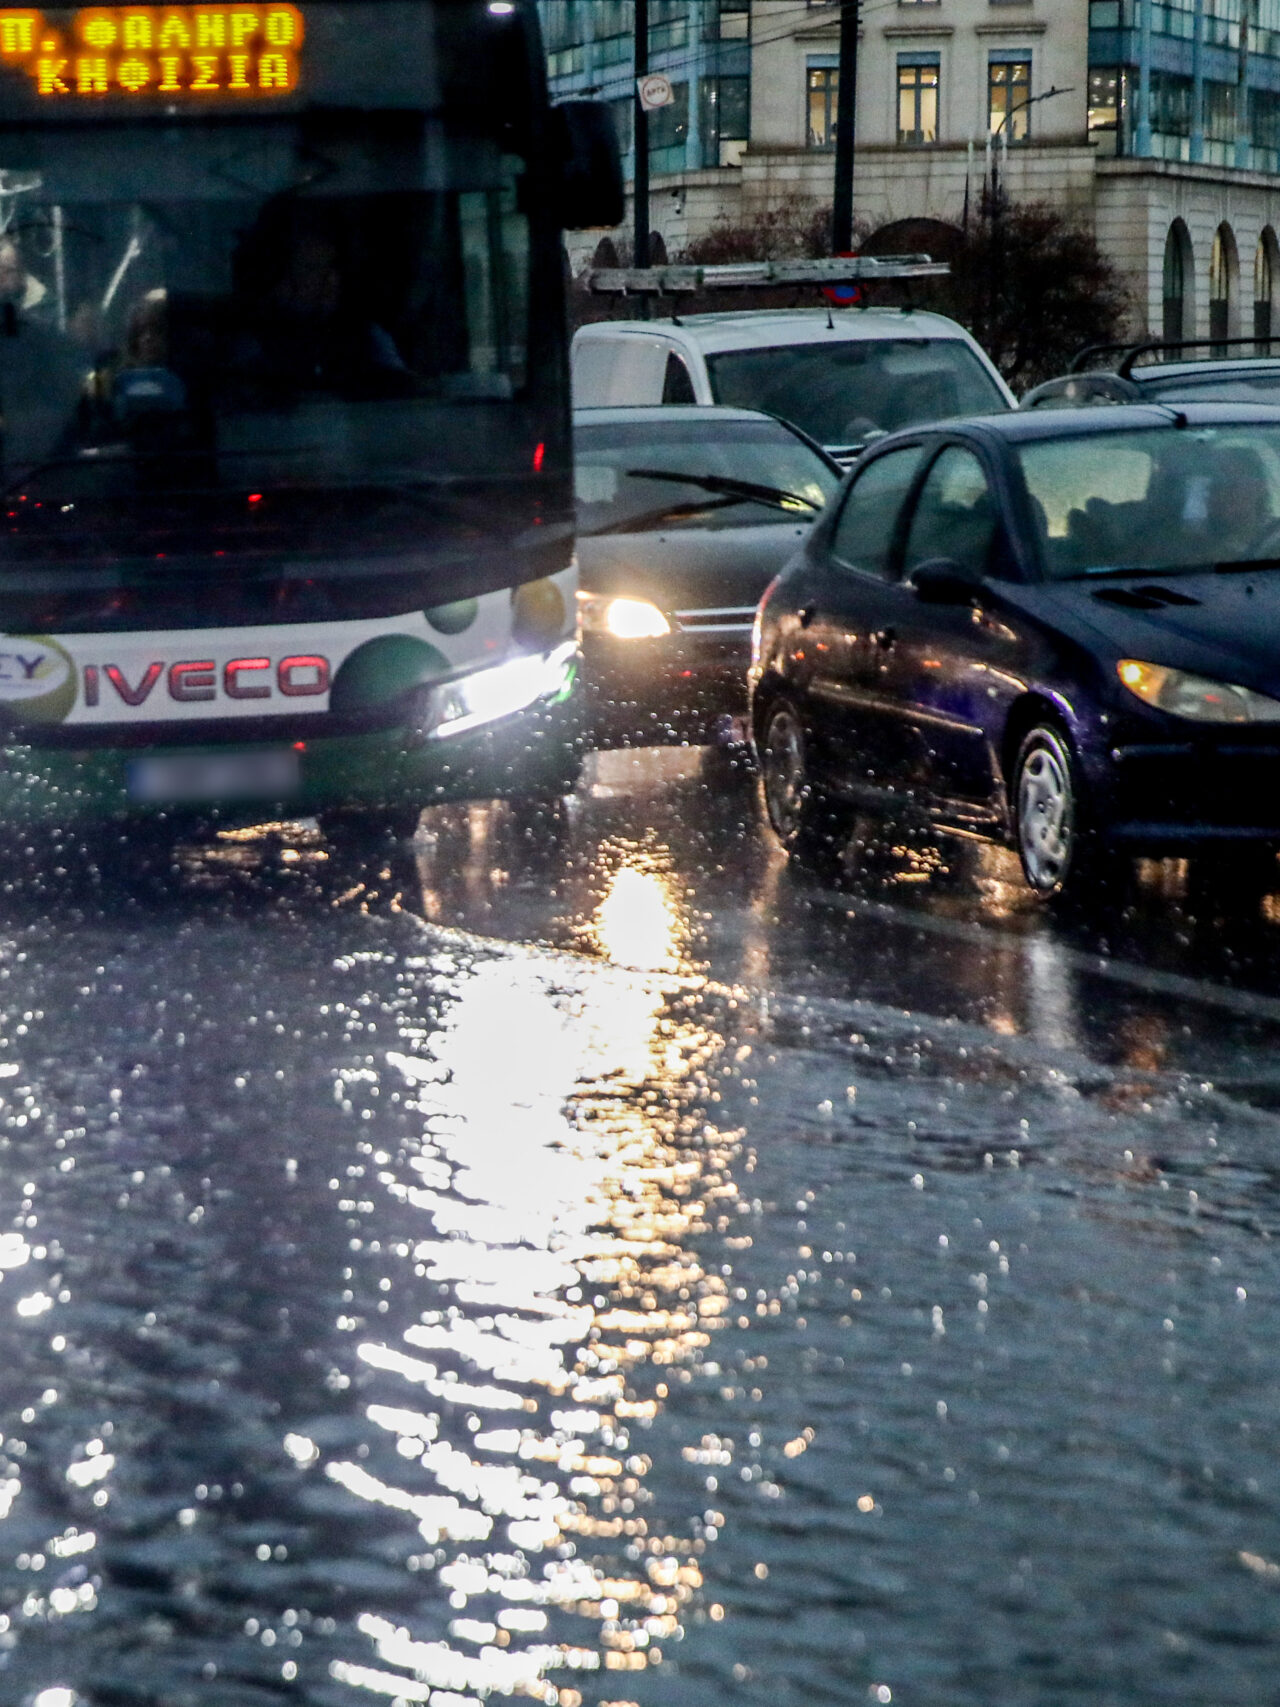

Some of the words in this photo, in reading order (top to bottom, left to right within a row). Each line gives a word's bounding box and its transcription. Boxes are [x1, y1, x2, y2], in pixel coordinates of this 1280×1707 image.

[83, 11, 295, 49] ΦΑΛΗΡΟ
[38, 53, 289, 93] ΚΗΦΙΣΙΑ
[82, 655, 331, 707] IVECO
